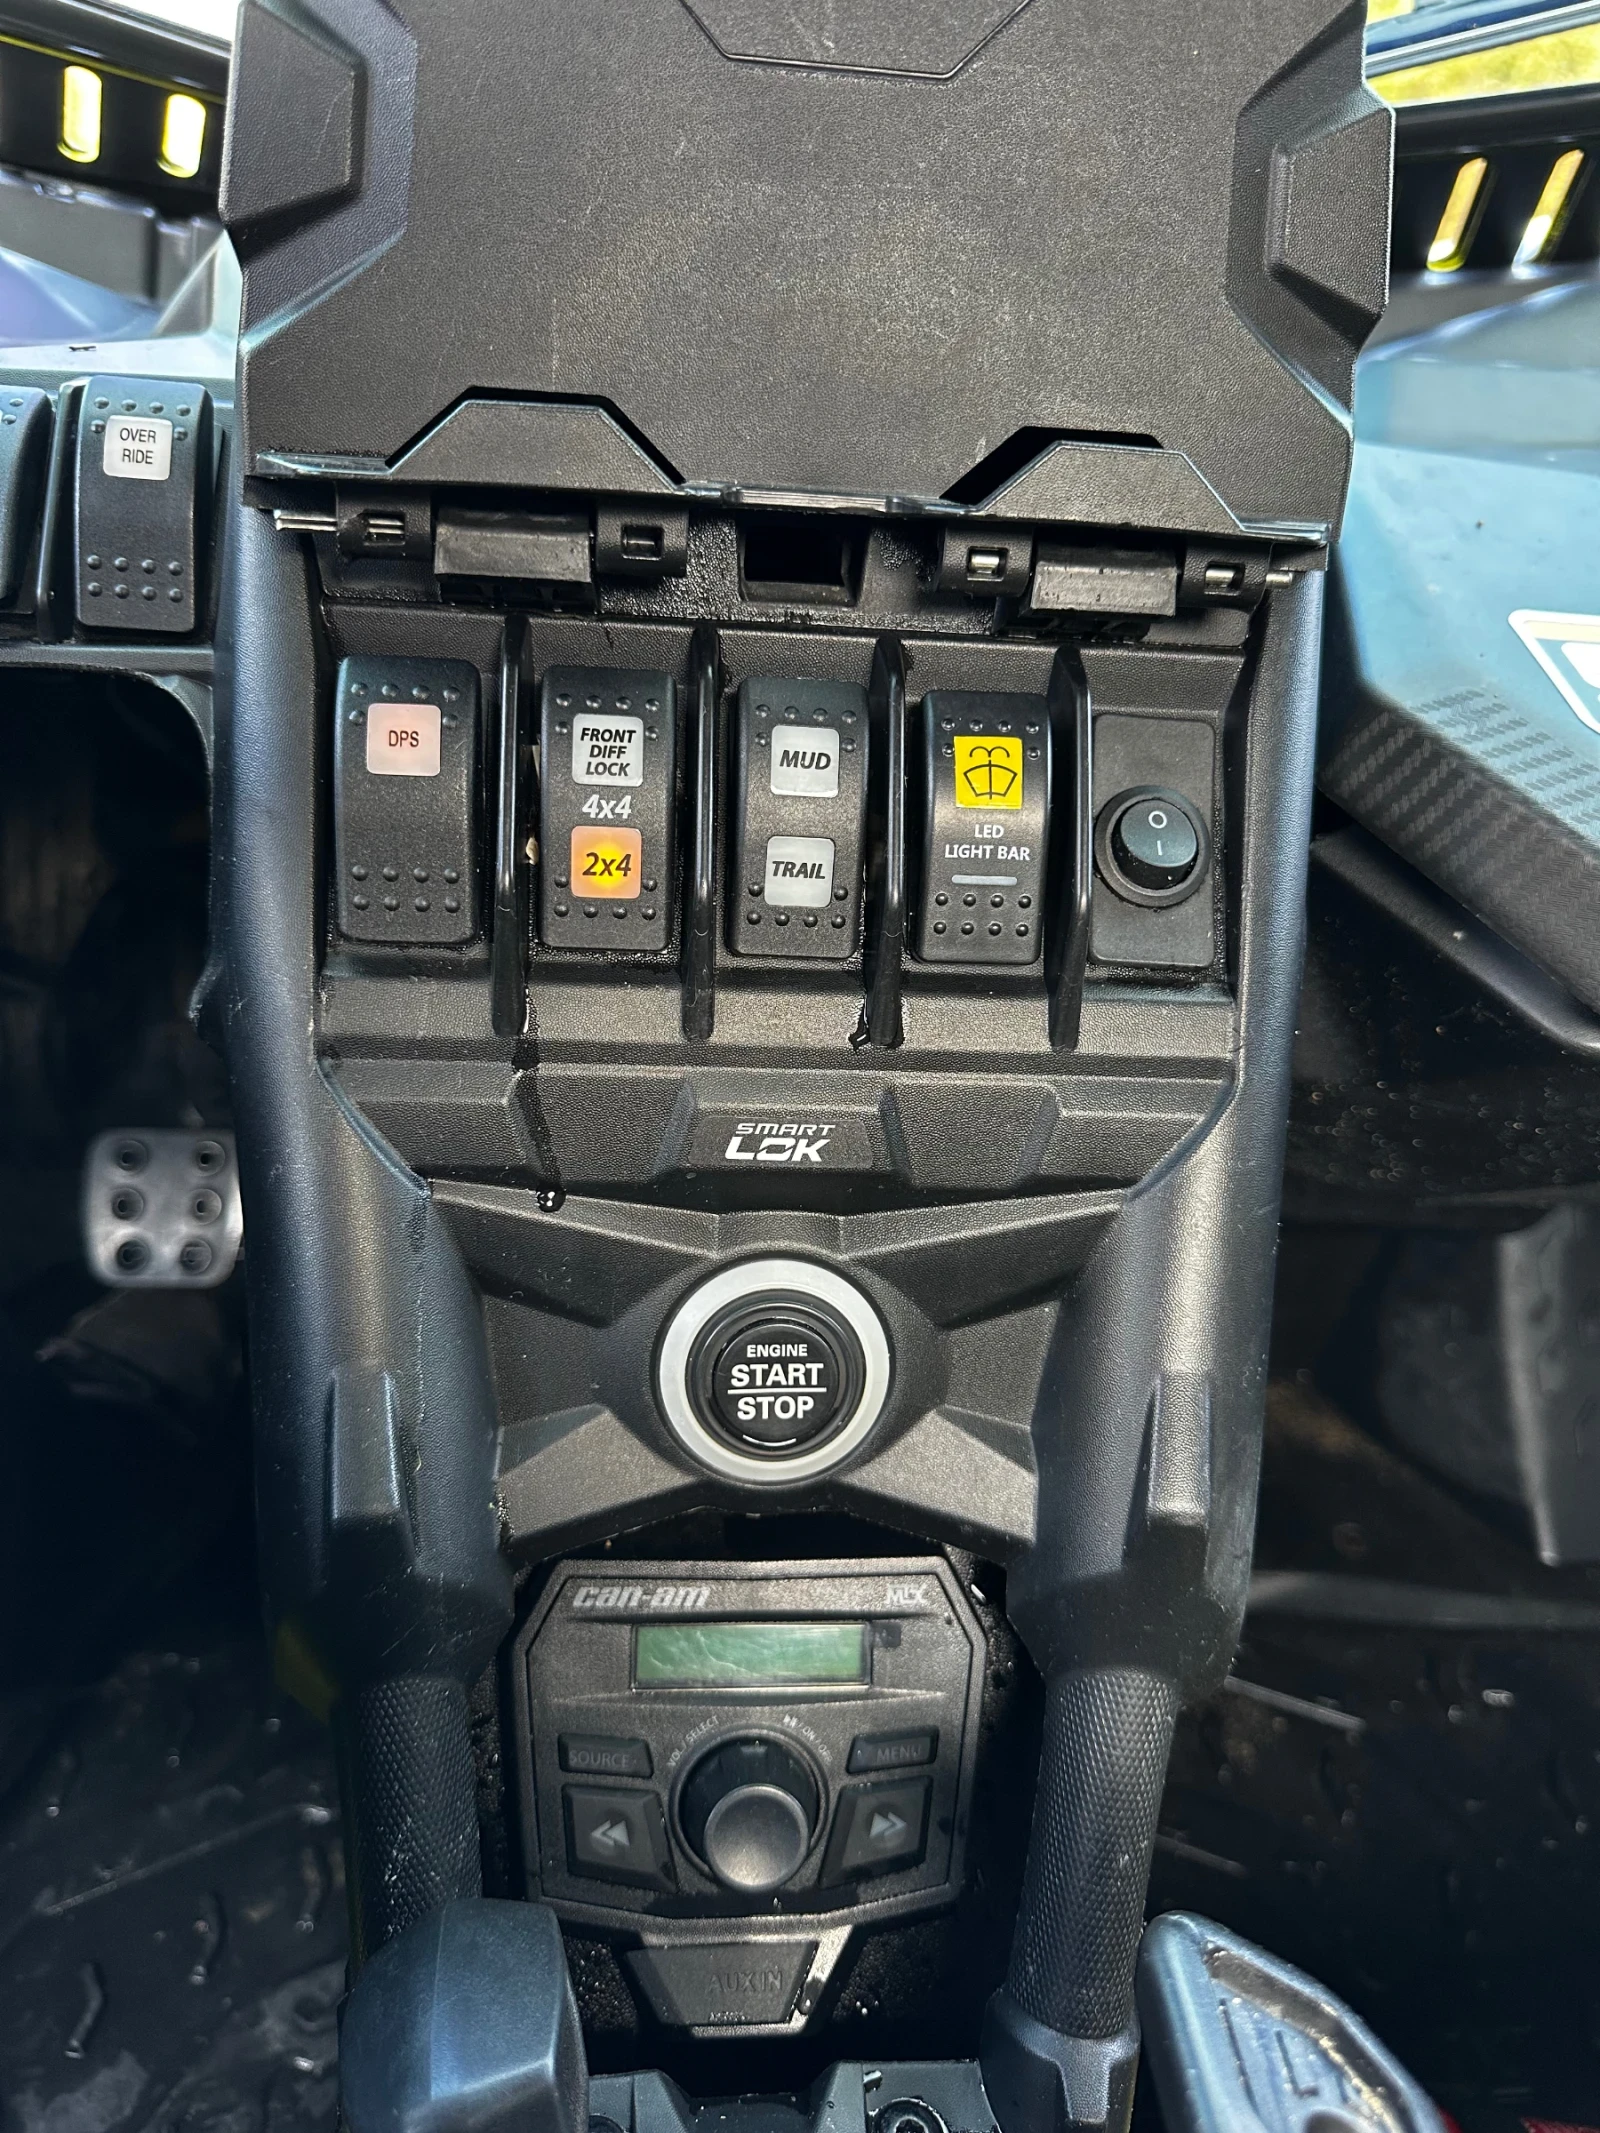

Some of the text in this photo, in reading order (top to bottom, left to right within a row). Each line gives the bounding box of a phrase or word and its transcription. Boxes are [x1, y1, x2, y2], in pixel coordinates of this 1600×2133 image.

[119, 427, 157, 444] OVER
[121, 447, 154, 465] RIDE
[388, 729, 420, 748] DPS
[580, 727, 637, 744] FRONT
[589, 745, 627, 759] DIFF
[779, 749, 832, 771] MUD
[585, 761, 631, 777] LOCK
[581, 794, 633, 820] 4x4
[974, 824, 1005, 839] LED
[944, 844, 1031, 862] LIGHT BAR
[582, 852, 633, 878] 2x4
[771, 859, 827, 881] TRAIL
[735, 1122, 835, 1136] SMART
[725, 1137, 832, 1162] LOK
[746, 1343, 808, 1358] ENGINE
[730, 1362, 825, 1388] START
[736, 1395, 815, 1420] STOP
[572, 1585, 711, 1607] can-am
[568, 1749, 630, 1769] SOURCE
[876, 1743, 922, 1764] MENU
[704, 1970, 783, 1993] AUX IN
